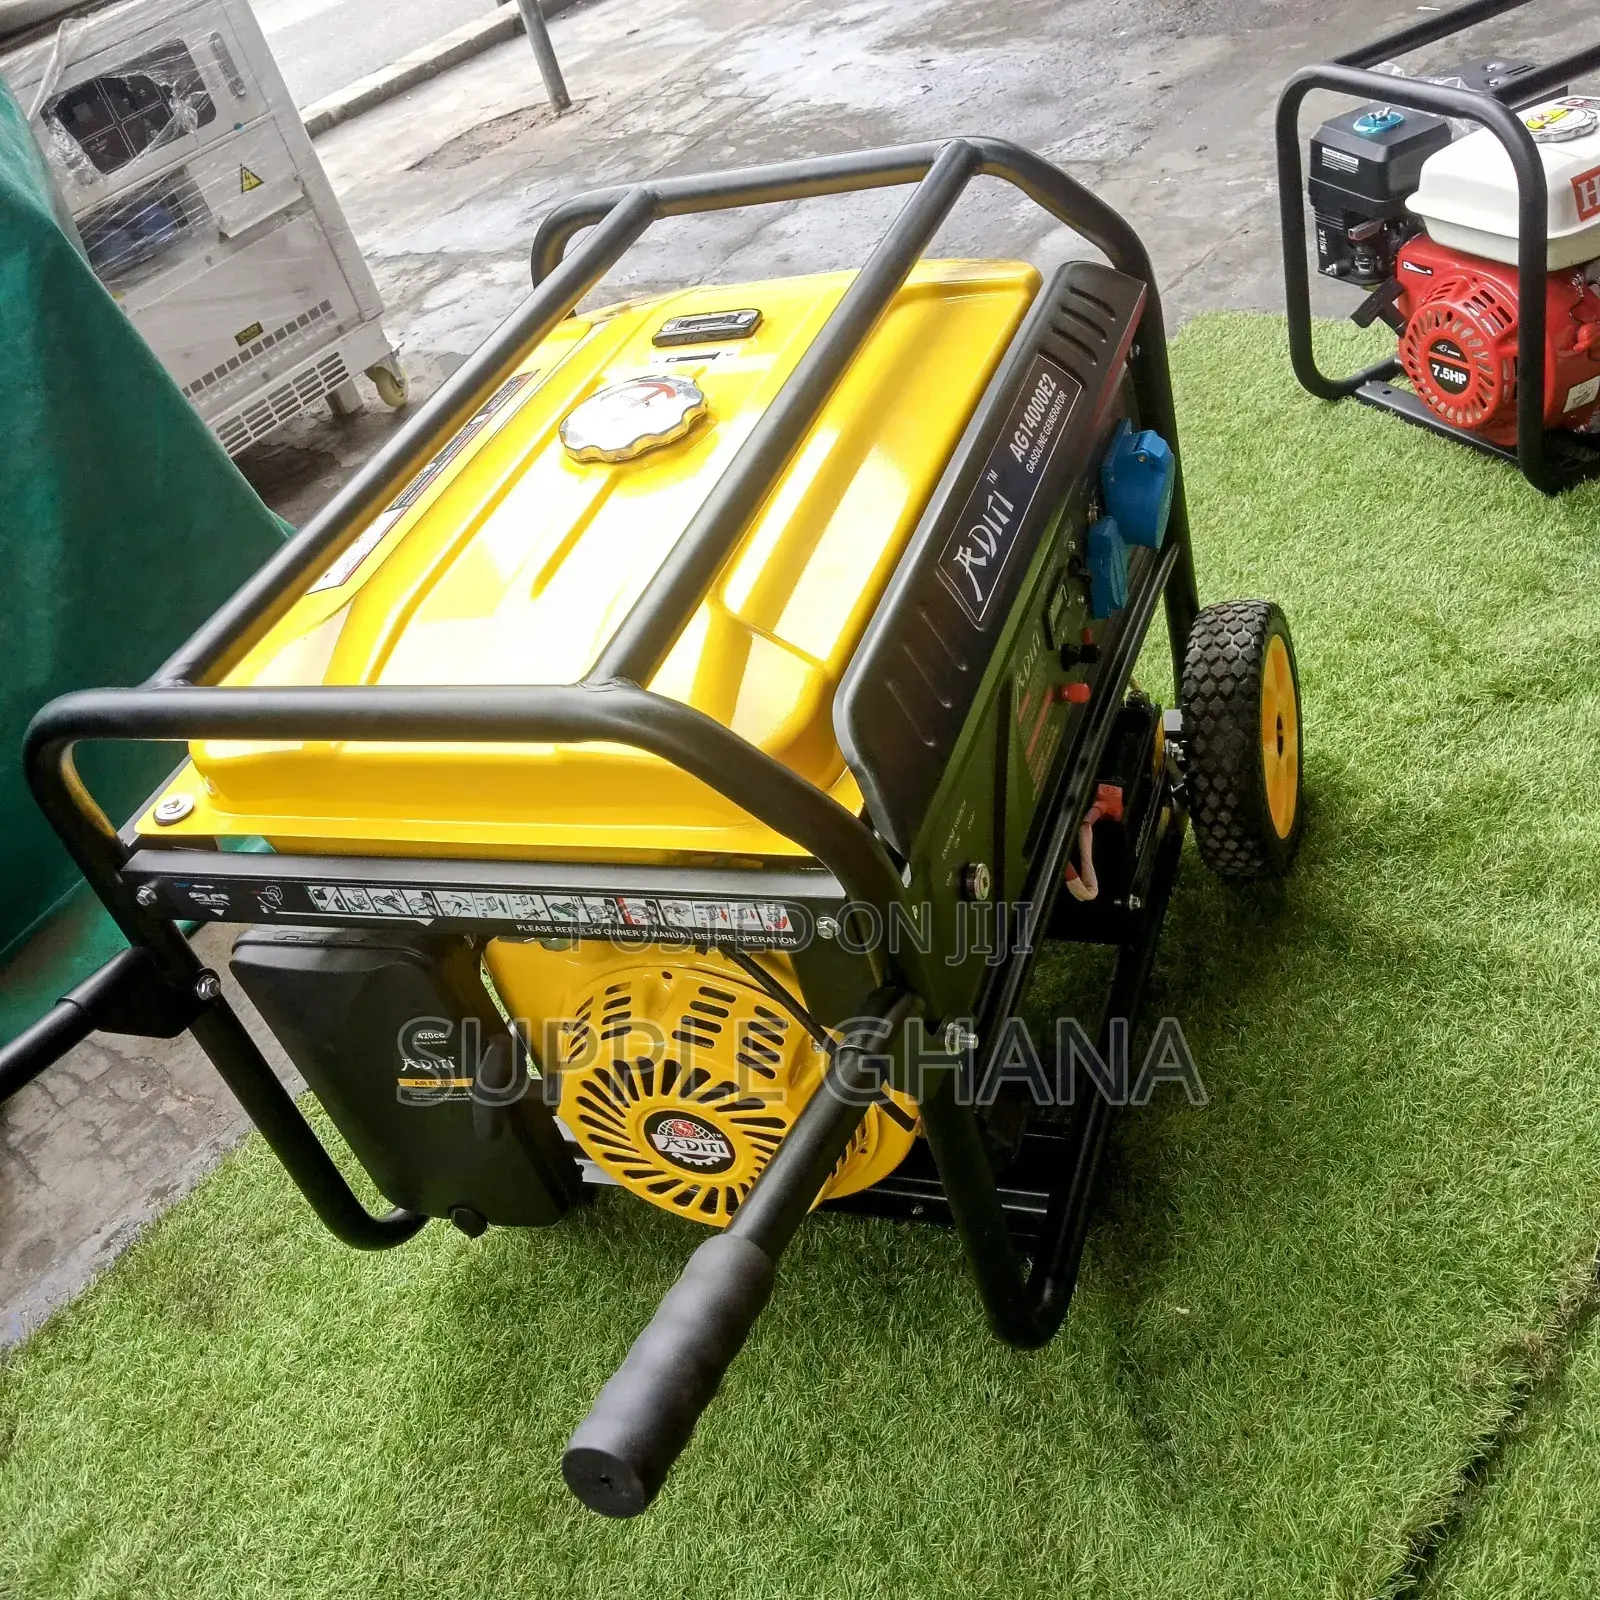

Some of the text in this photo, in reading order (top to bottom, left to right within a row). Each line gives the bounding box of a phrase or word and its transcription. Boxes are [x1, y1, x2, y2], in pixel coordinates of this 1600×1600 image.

[1431, 363, 1467, 385] 7.5HP
[1009, 373, 1057, 463] AG14000E2
[1026, 390, 1068, 474] GASOLINE GENERATOR
[516, 924, 554, 933] PLEASE
[555, 926, 587, 935] REFER
[603, 928, 648, 938] OWNER'S
[651, 930, 693, 941] MANUAL
[694, 932, 736, 943] BEFORE
[737, 934, 797, 945] OPERATION
[417, 1032, 446, 1040] 420cc
